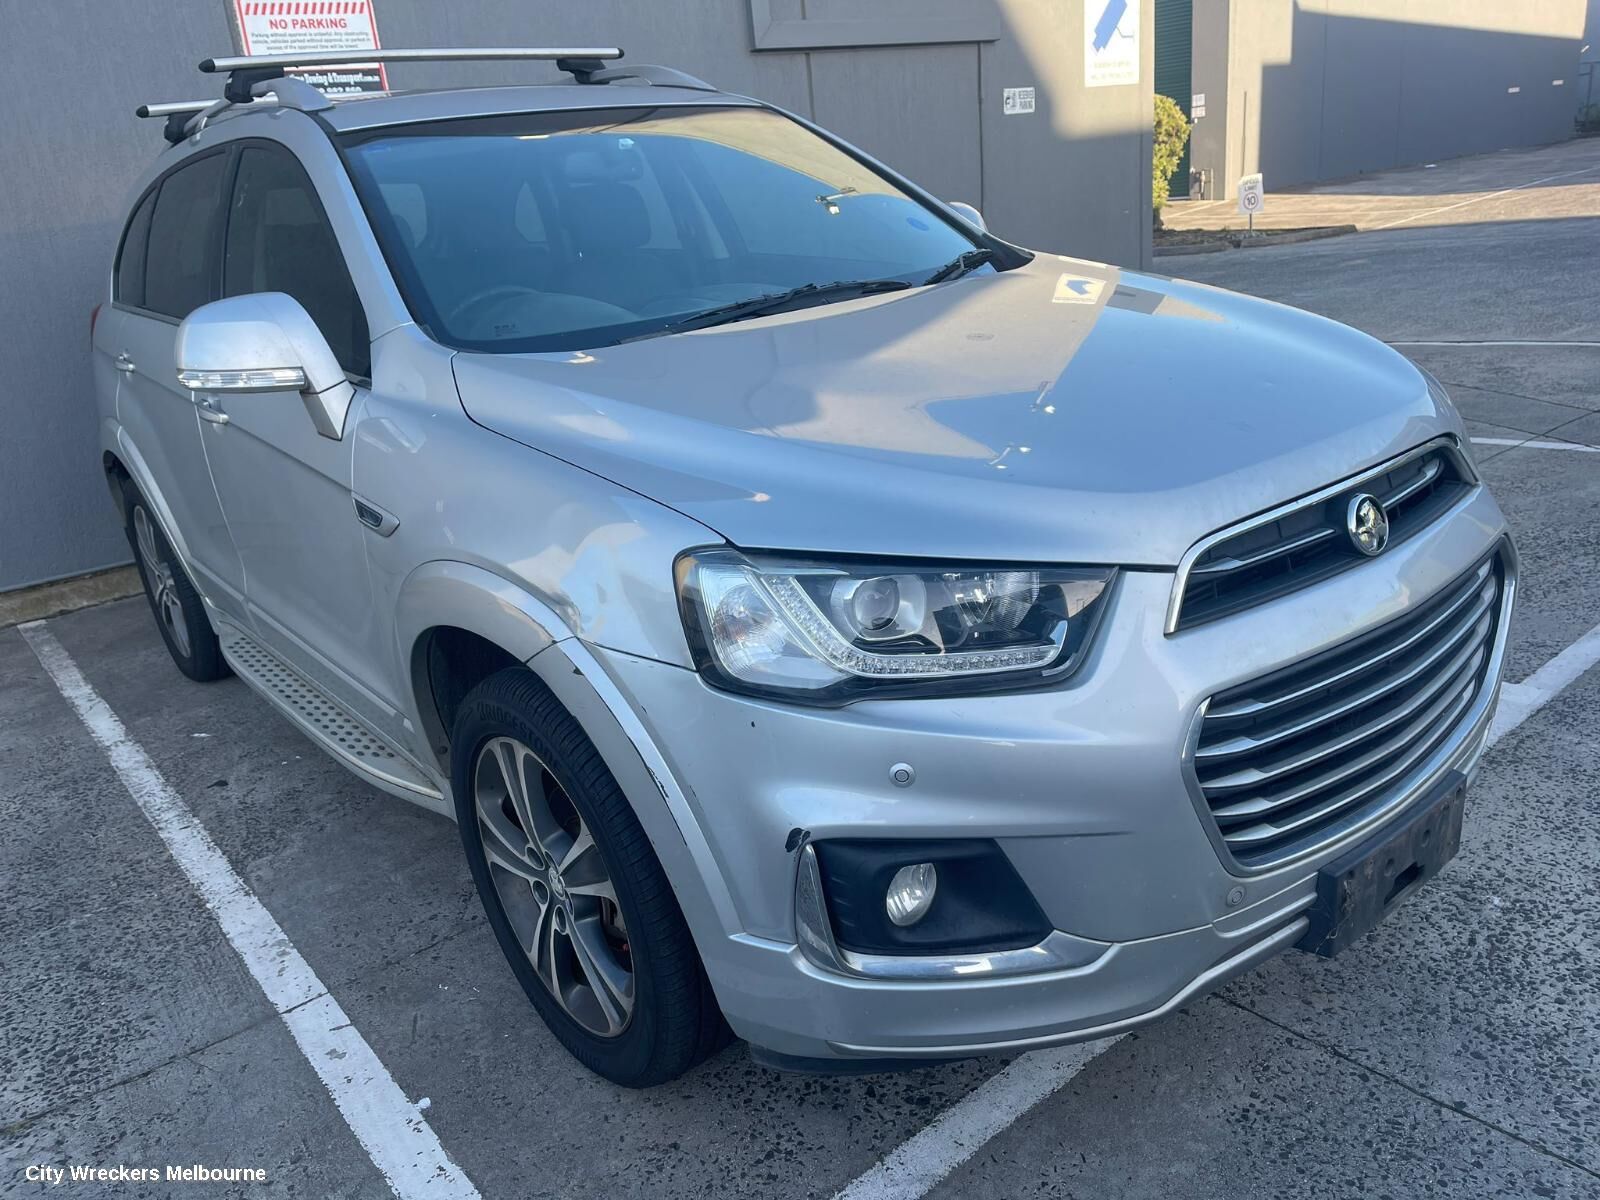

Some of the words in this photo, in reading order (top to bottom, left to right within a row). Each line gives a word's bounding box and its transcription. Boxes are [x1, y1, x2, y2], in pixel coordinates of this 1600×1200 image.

[269, 19, 288, 29] NO
[292, 18, 348, 29] PARKING
[304, 73, 328, 86] Towing
[1247, 196, 1256, 206] 10
